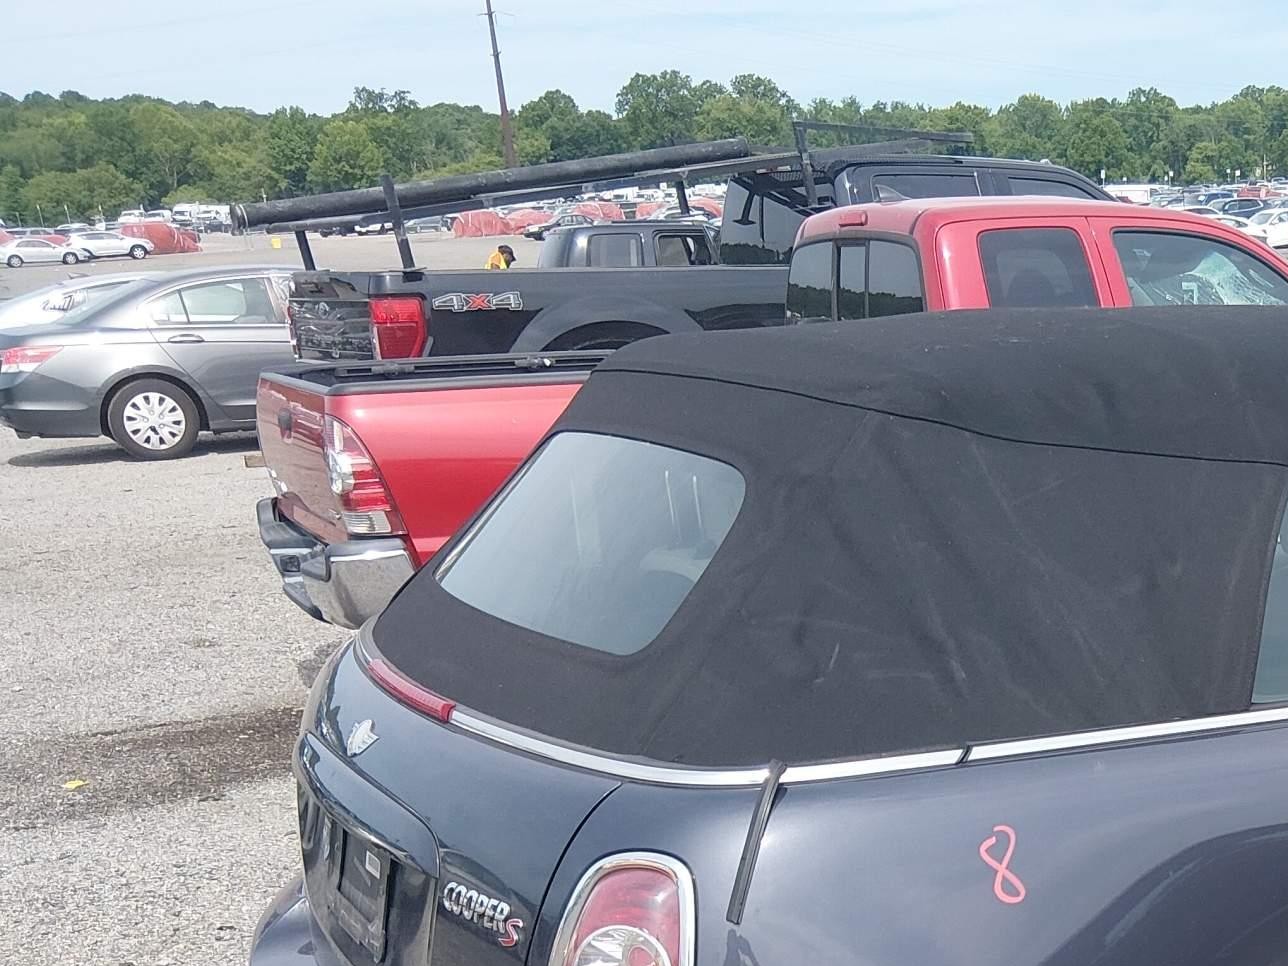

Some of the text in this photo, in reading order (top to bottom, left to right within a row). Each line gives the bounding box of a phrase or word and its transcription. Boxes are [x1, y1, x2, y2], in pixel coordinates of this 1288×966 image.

[979, 823, 1028, 905] 8
[442, 881, 524, 947] COOPER S
